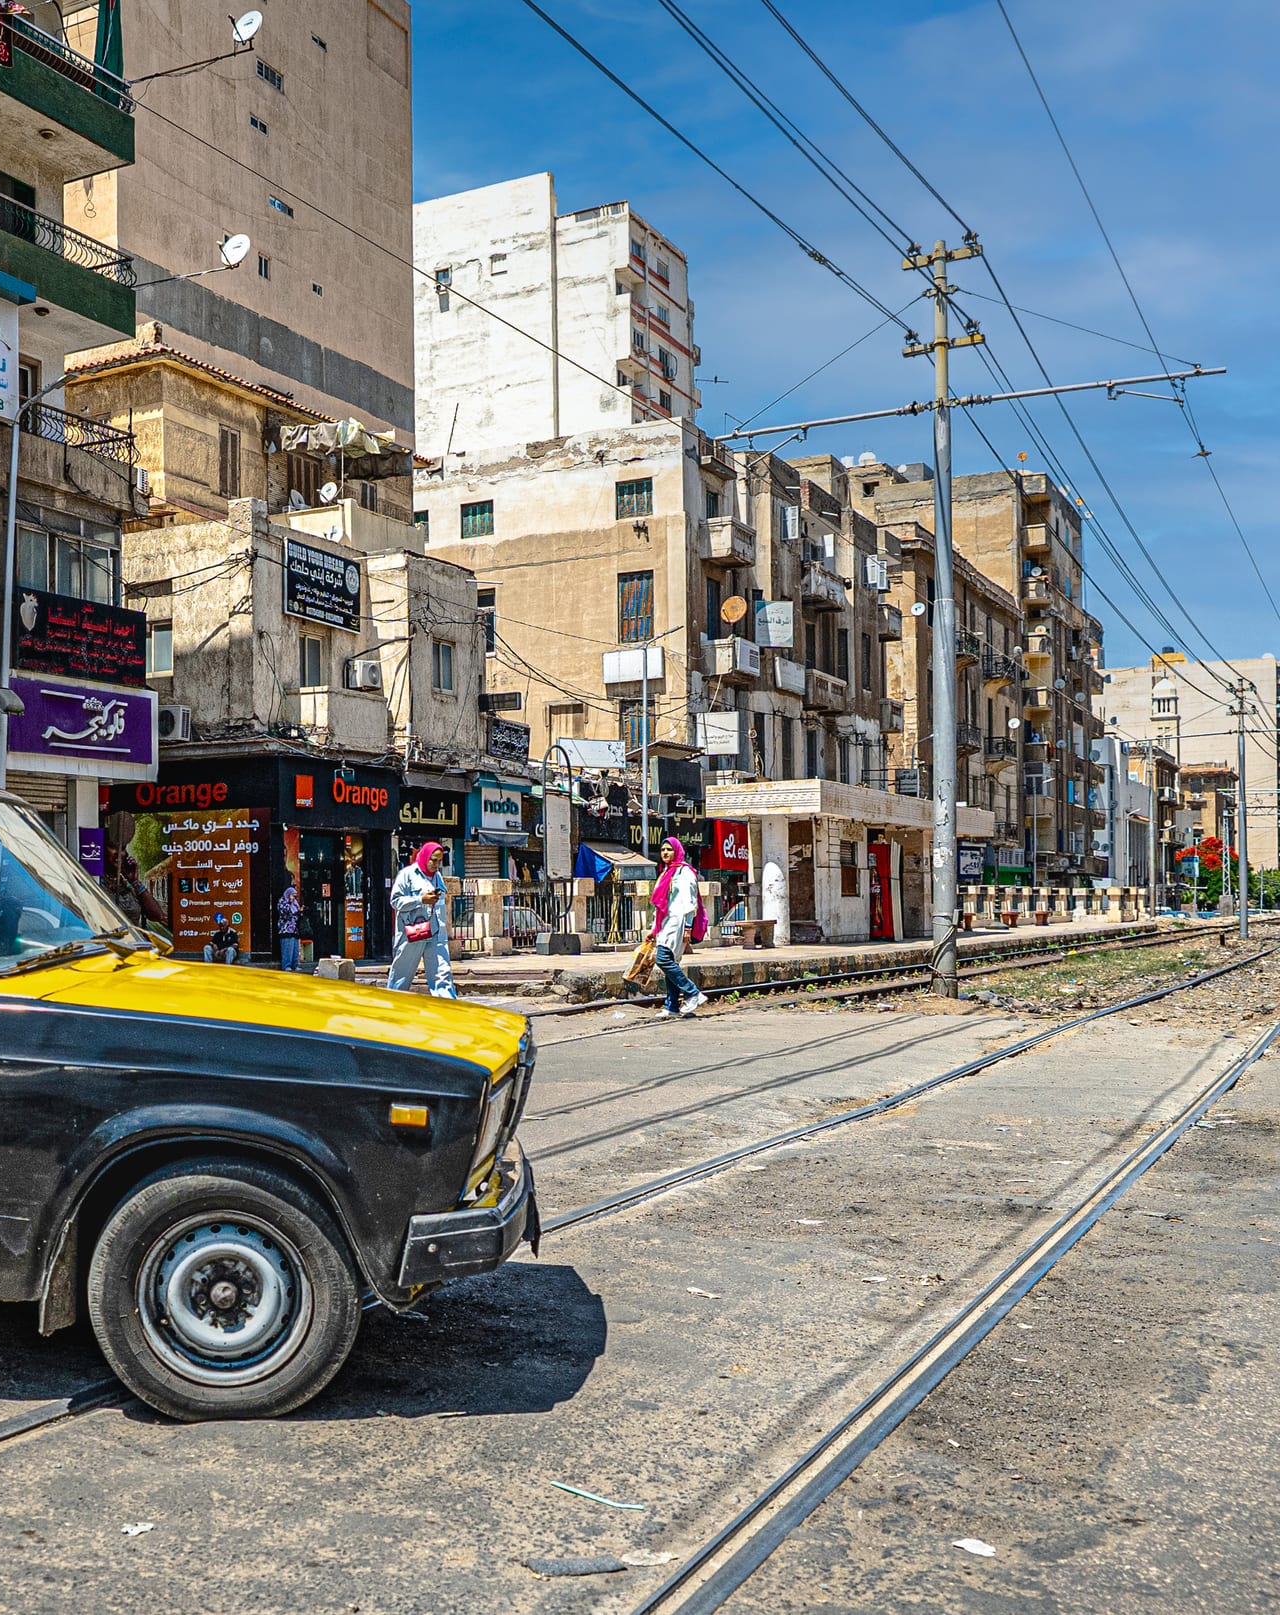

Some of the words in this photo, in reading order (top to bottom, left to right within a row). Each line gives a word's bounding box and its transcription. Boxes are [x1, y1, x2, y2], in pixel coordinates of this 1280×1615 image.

[135, 782, 228, 809] Orange
[333, 777, 389, 812] Orange
[162, 818, 200, 834] ماكس
[202, 817, 233, 834] فري
[235, 819, 260, 831] جدد
[629, 825, 663, 845] TOMY
[161, 841, 184, 855] جنيه
[184, 840, 212, 852] 3000
[213, 839, 231, 852] لحد
[233, 839, 259, 854] ووفر
[177, 859, 213, 869] السنة
[214, 859, 243, 873] في
